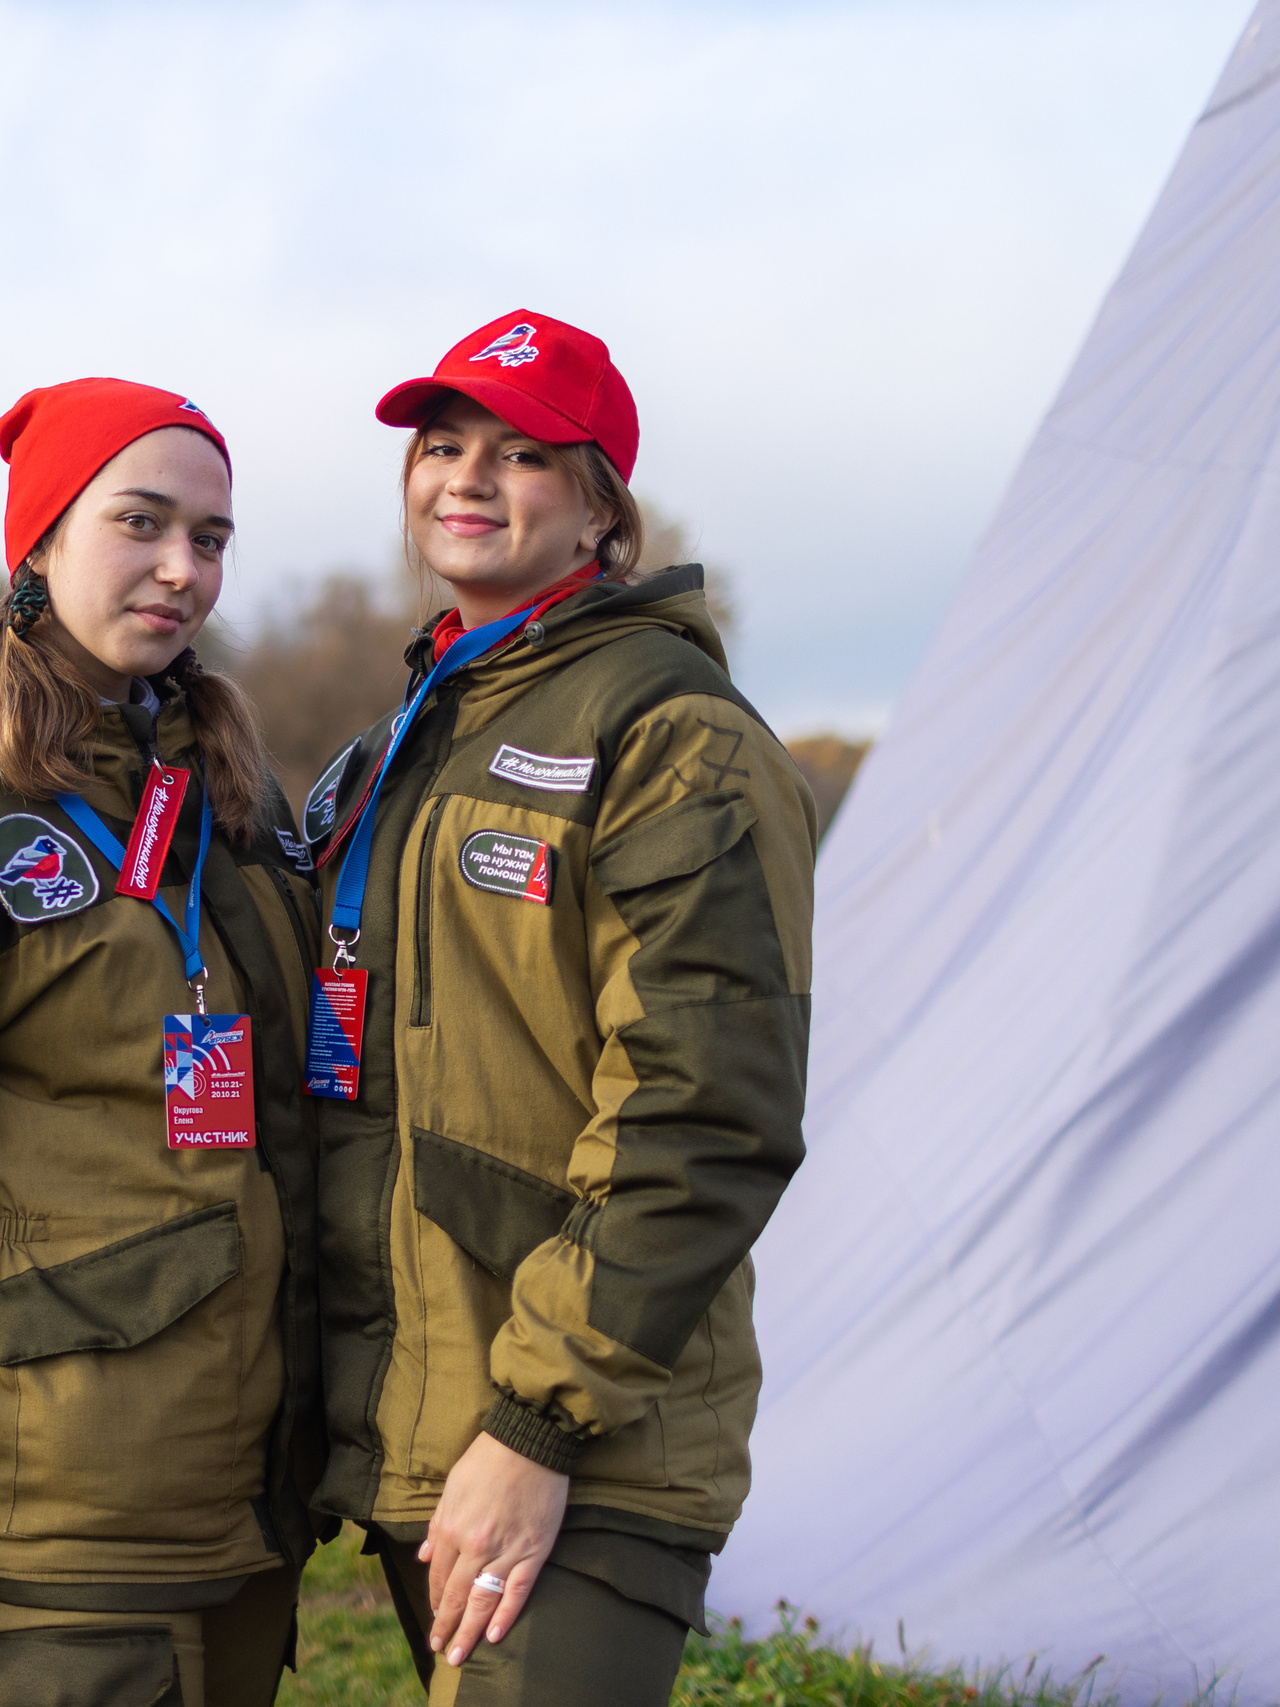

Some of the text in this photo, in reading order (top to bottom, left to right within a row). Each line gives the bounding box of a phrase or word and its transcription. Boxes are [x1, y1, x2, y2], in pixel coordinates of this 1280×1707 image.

[492, 843, 535, 861] Мы там,
[469, 851, 531, 872] где нужна
[478, 865, 527, 883] помощь
[174, 1116, 194, 1124] Елена
[175, 1131, 249, 1144] УЧАСТНИК
